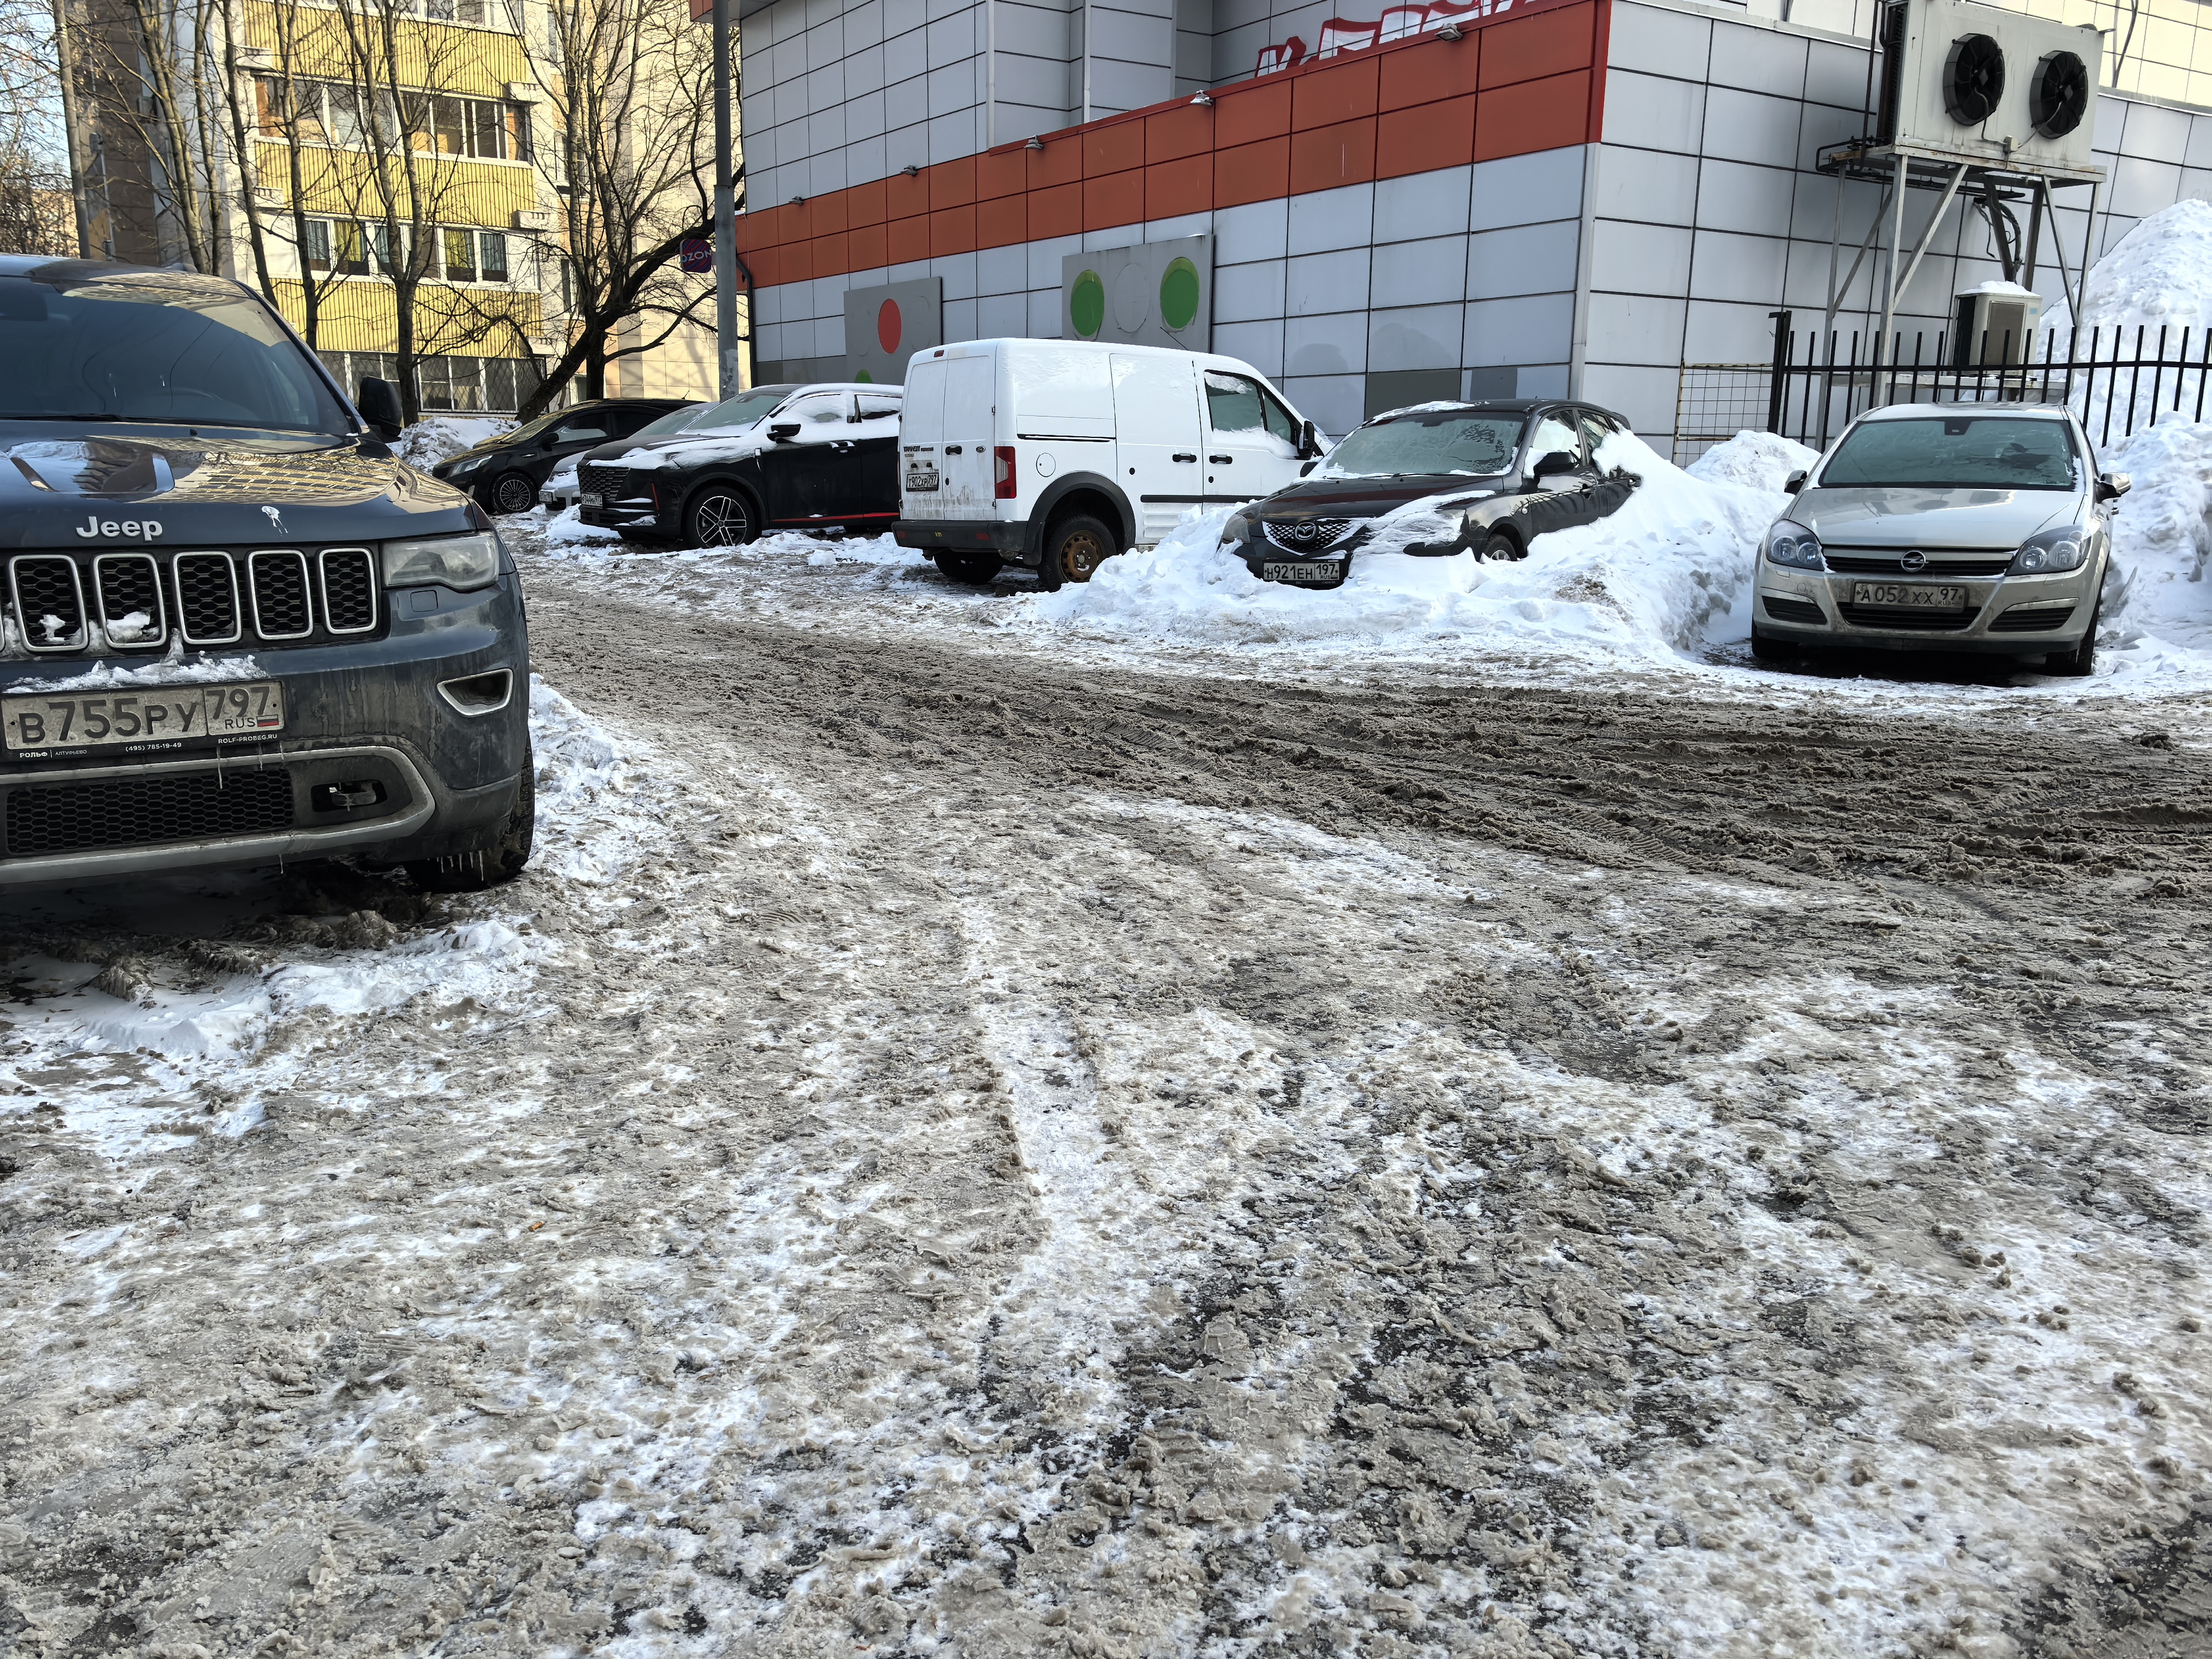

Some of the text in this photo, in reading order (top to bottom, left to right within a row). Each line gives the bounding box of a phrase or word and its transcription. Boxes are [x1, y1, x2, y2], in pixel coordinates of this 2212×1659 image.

[682, 249, 712, 262] OZON
[928, 474, 937, 484] 797
[75, 516, 163, 542] Jeep
[1267, 564, 1336, 579] Н921ЕН 197
[1861, 586, 1959, 605] А052ХХ 97
[18, 686, 270, 744] В755РУ 797
[225, 718, 256, 730] RUS
[218, 733, 277, 744] ROLF-PROBEG.RU
[147, 742, 181, 750] 785-19-49
